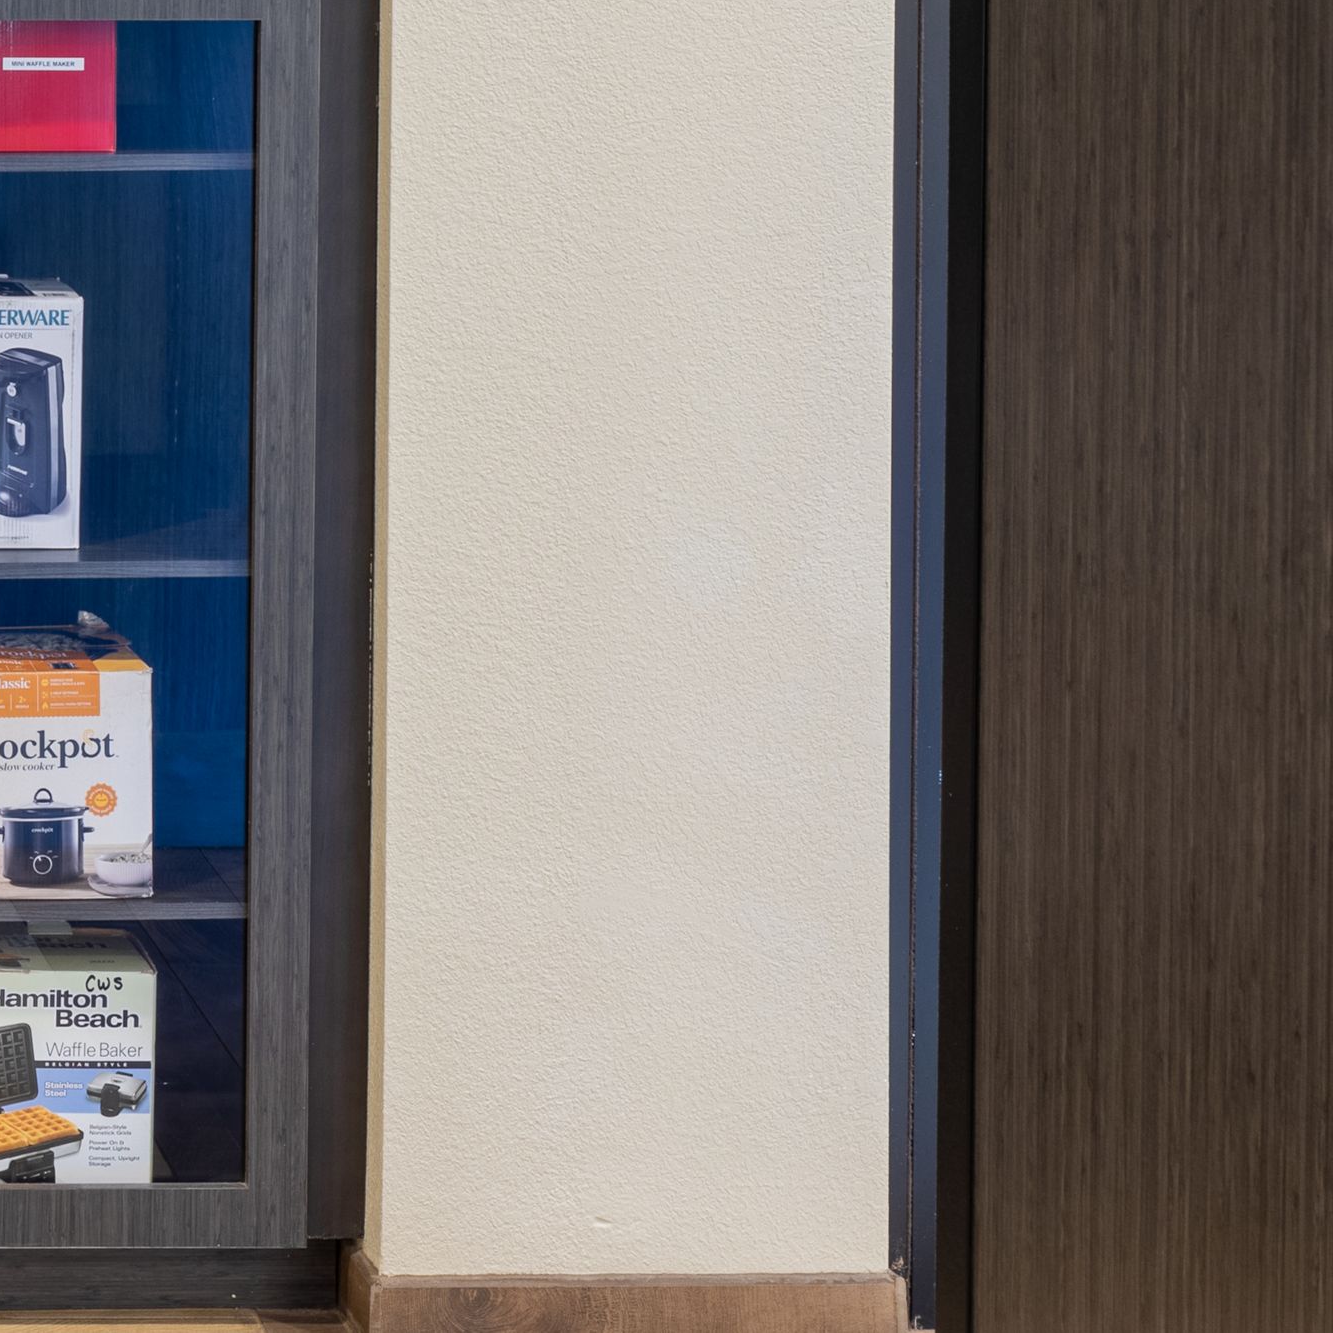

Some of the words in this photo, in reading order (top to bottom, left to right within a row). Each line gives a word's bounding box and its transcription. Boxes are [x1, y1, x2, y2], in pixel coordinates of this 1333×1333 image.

[0, 763, 22, 772] slow
[23, 761, 56, 772] cooker
[85, 974, 123, 992] CWS
[56, 1009, 139, 1028] Beach
[46, 1042, 96, 1058] Waffle
[99, 1042, 144, 1058] Baker
[44, 1081, 83, 1090] Stainless
[44, 1089, 67, 1097] Steel
